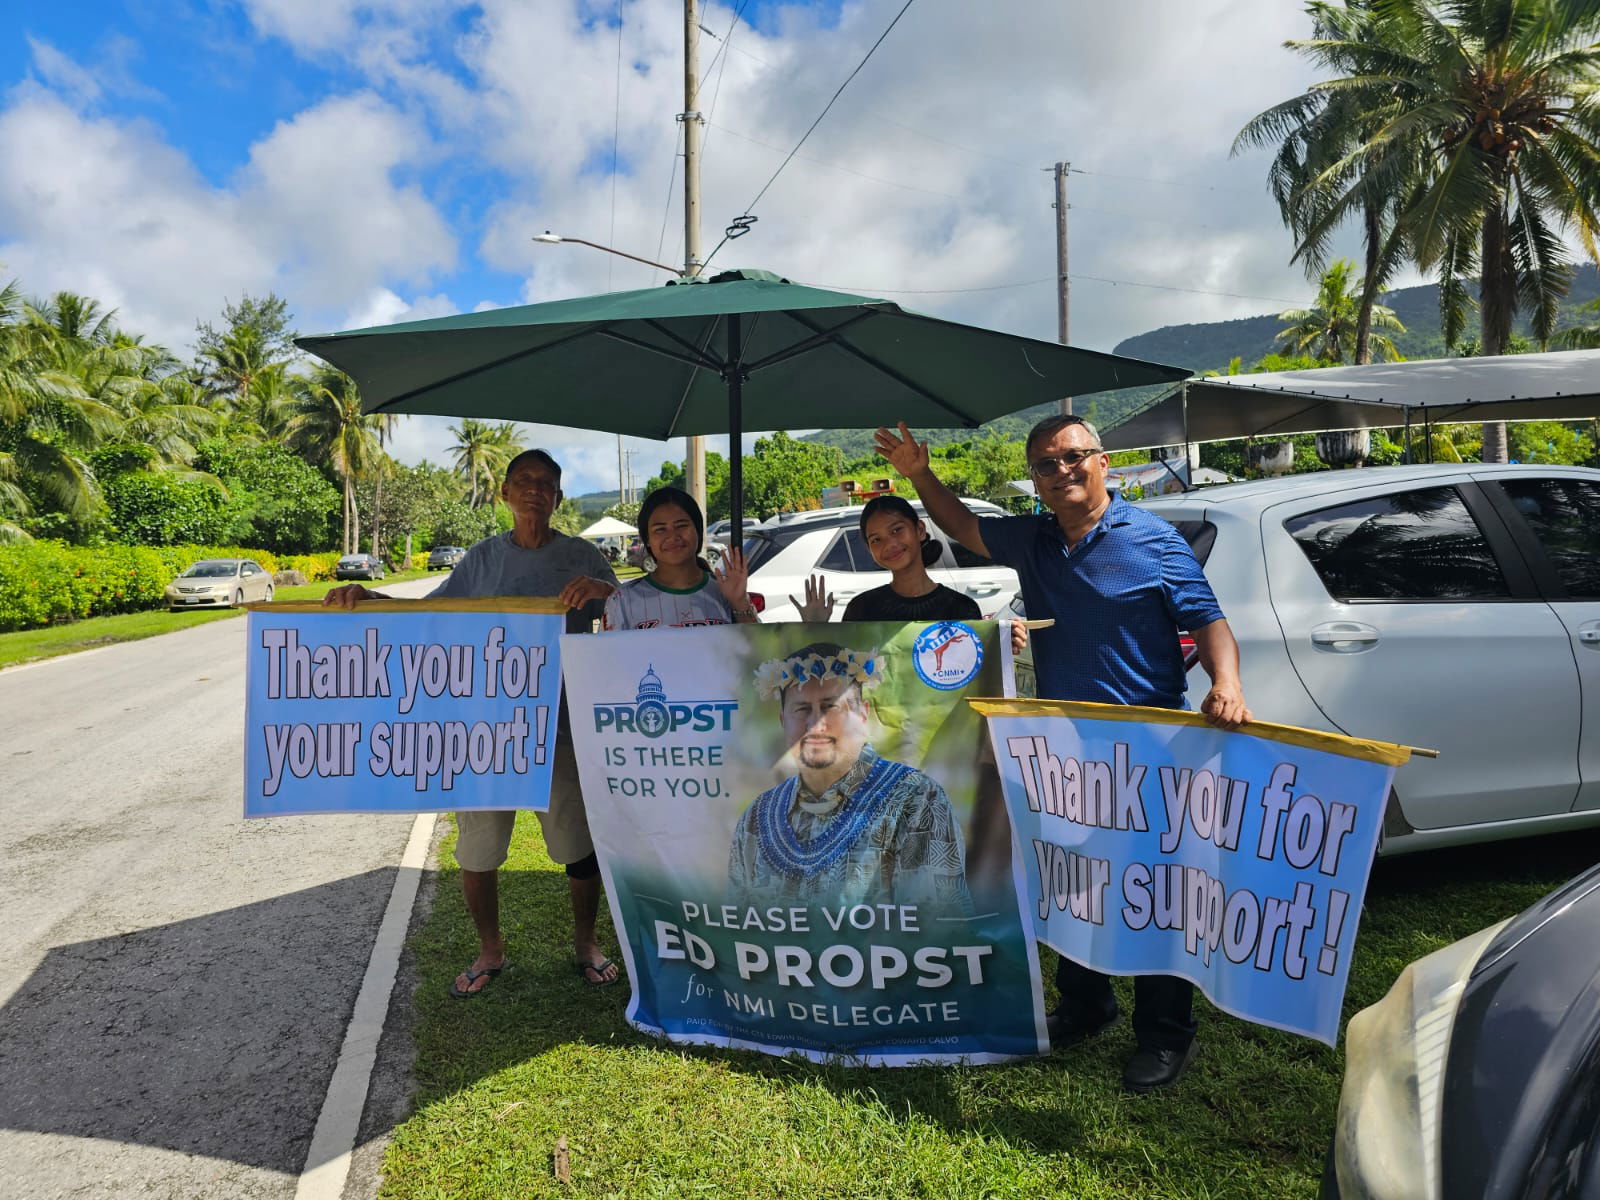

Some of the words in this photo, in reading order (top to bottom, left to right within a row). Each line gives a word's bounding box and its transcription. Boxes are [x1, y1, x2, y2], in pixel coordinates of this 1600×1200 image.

[262, 628, 392, 699] Thank
[399, 644, 474, 714] you
[484, 626, 546, 698] for
[593, 701, 738, 738] PROPST
[263, 721, 361, 796] your
[605, 747, 626, 766] IS
[634, 746, 723, 766] THERE
[607, 777, 656, 797] FOR
[664, 778, 730, 797] YOU.
[1007, 735, 1149, 832] Thank
[1159, 766, 1249, 853] you
[1257, 762, 1357, 876] for
[1032, 839, 1110, 925] your
[682, 900, 810, 932] PLEASE
[821, 904, 920, 932] VOTE
[654, 919, 716, 970] ED
[734, 942, 993, 989] PROPST
[681, 973, 714, 1003] for
[723, 989, 775, 1018] NMI
[787, 1001, 960, 1026] DELEGATE
[686, 1017, 706, 1026] PAID
[928, 1036, 959, 1044] CALVO
